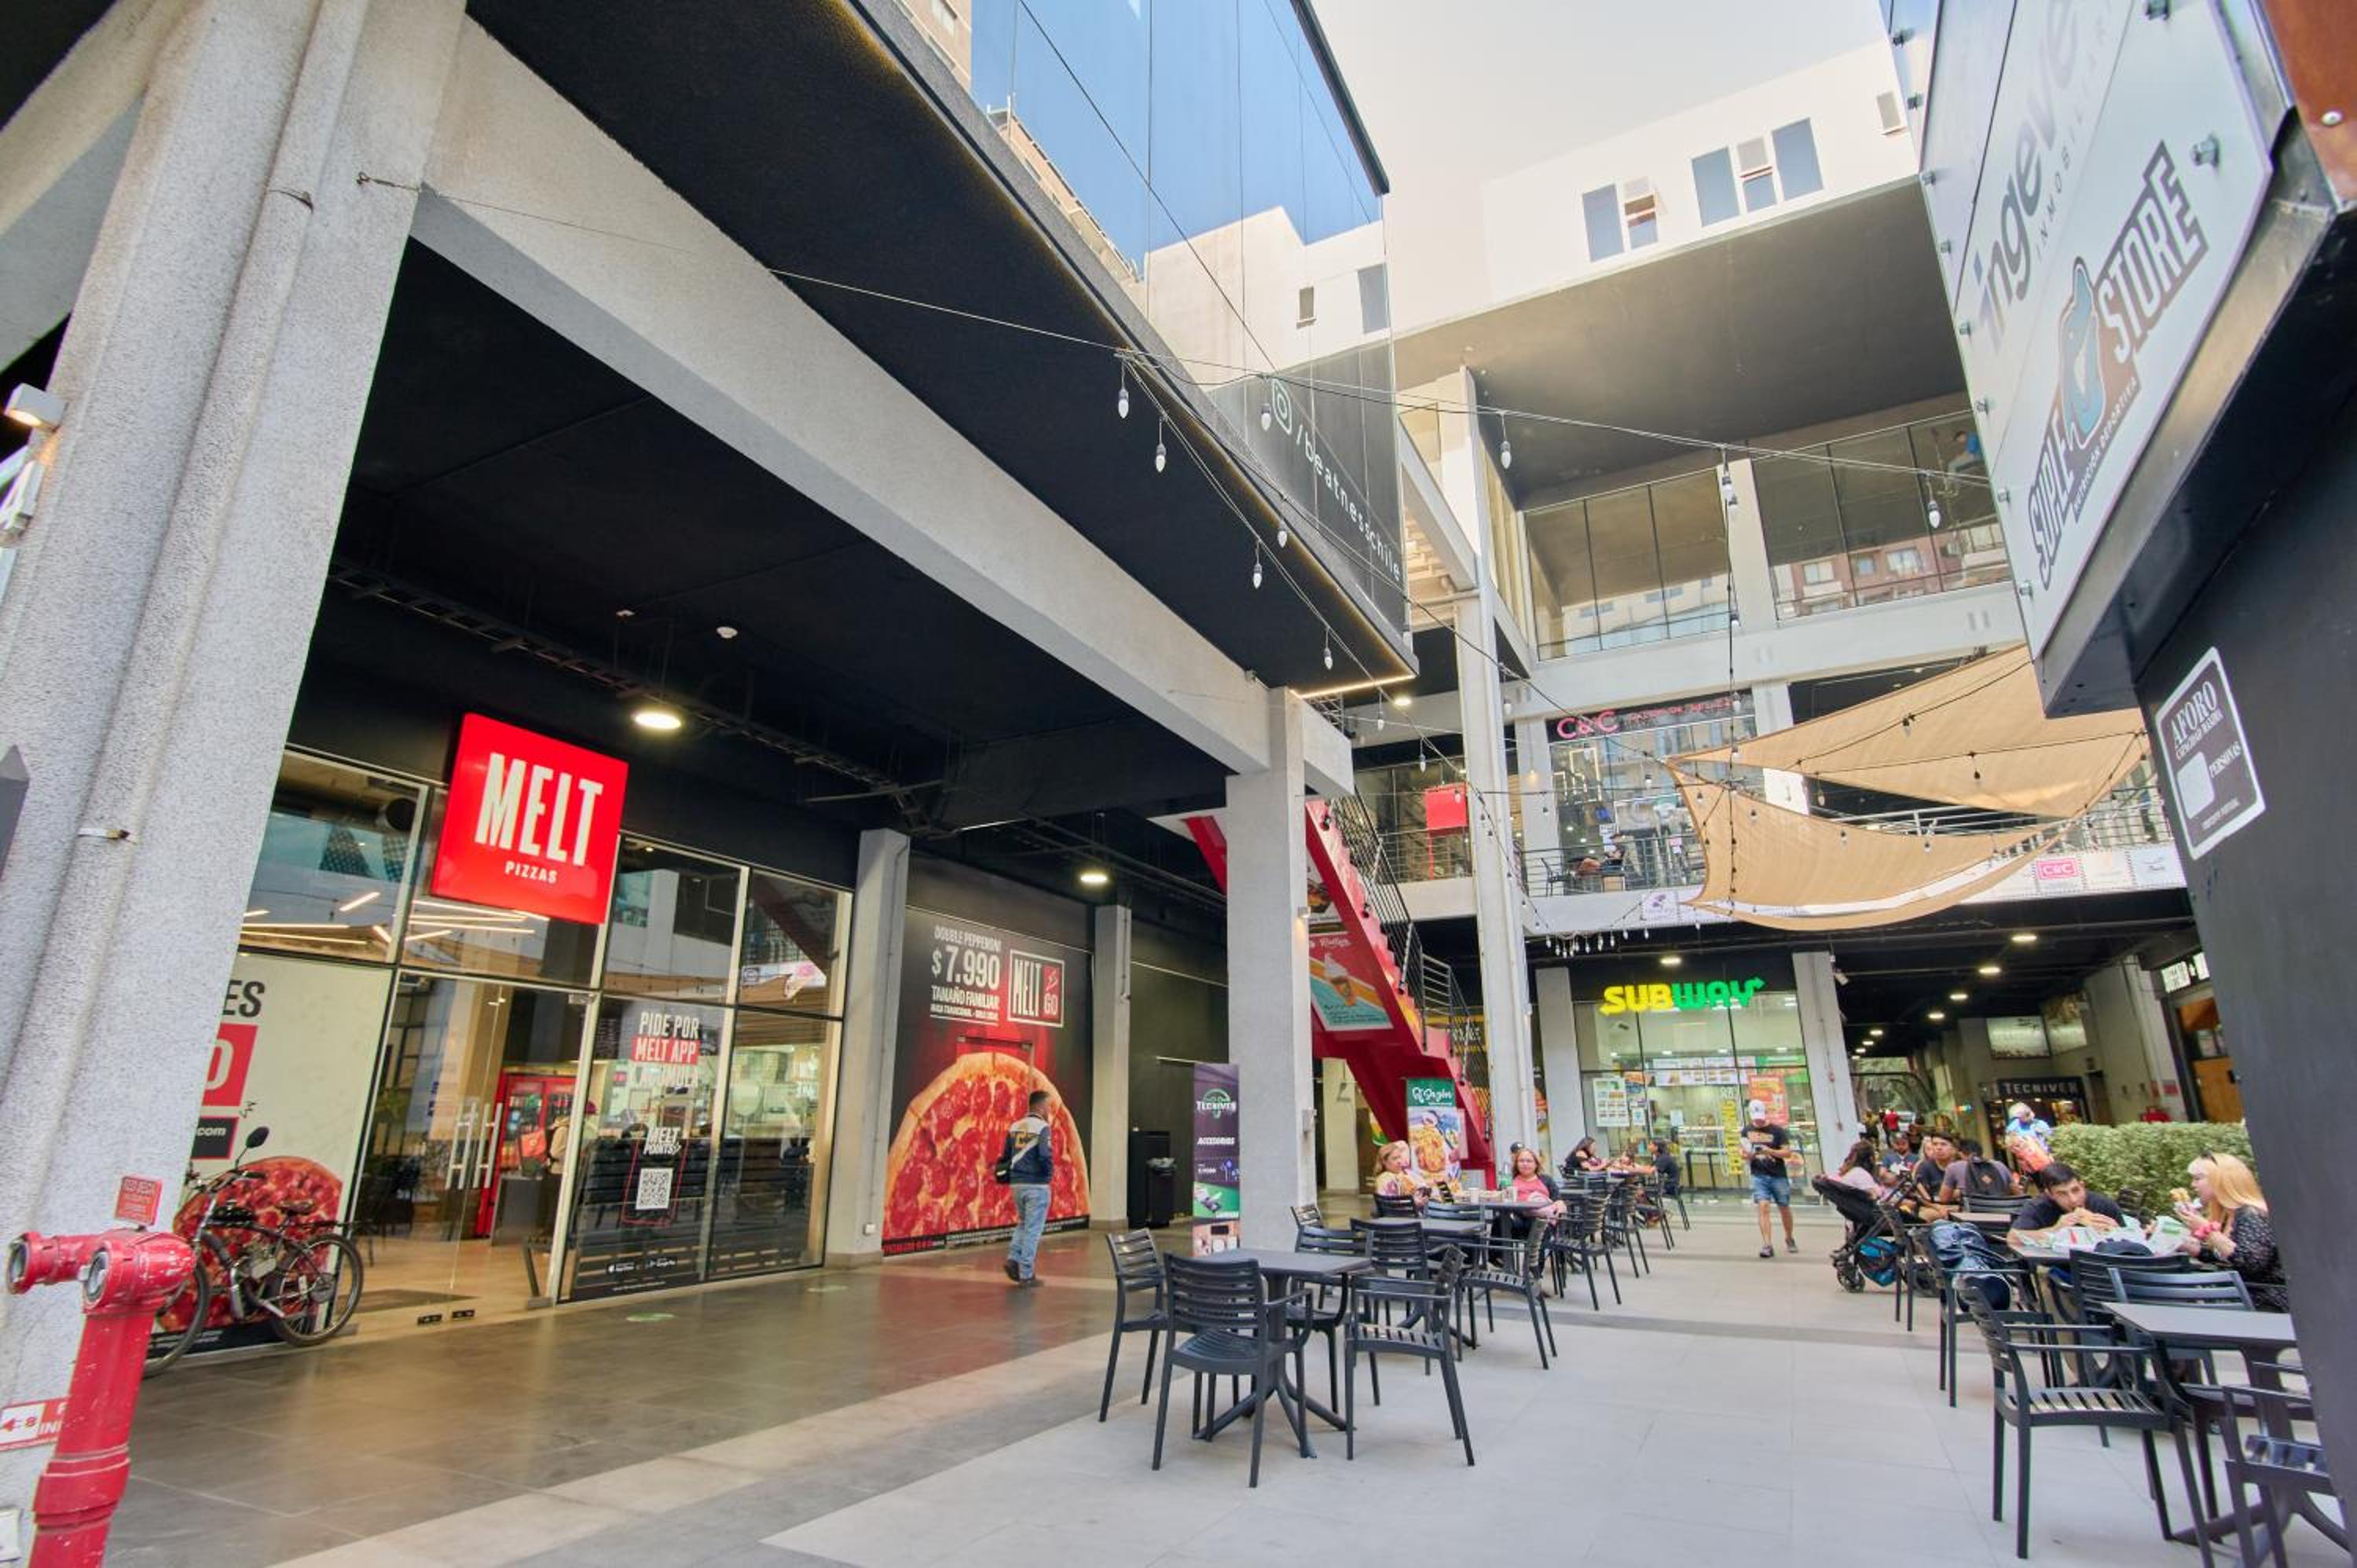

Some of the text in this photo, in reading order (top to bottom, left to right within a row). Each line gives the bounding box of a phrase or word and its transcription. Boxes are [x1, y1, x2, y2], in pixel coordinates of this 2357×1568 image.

[2029, 155, 2201, 588] SUPLE STORE
[1557, 709, 1618, 740] C&C
[2171, 681, 2217, 748] AFORO
[474, 752, 604, 867] MELT
[504, 860, 559, 885] PIZZAS
[930, 984, 1000, 1011] TAMAÑO FAMILIAR
[1013, 958, 1042, 1017] MELT
[1600, 977, 1765, 1017] SUBWAY
[1043, 992, 1058, 1016] GO
[639, 1011, 699, 1039] PIDE POR
[634, 1037, 669, 1062] MELT
[670, 1039, 697, 1064] APP
[647, 1127, 681, 1143] MELT
[643, 1143, 676, 1156] POINTS
